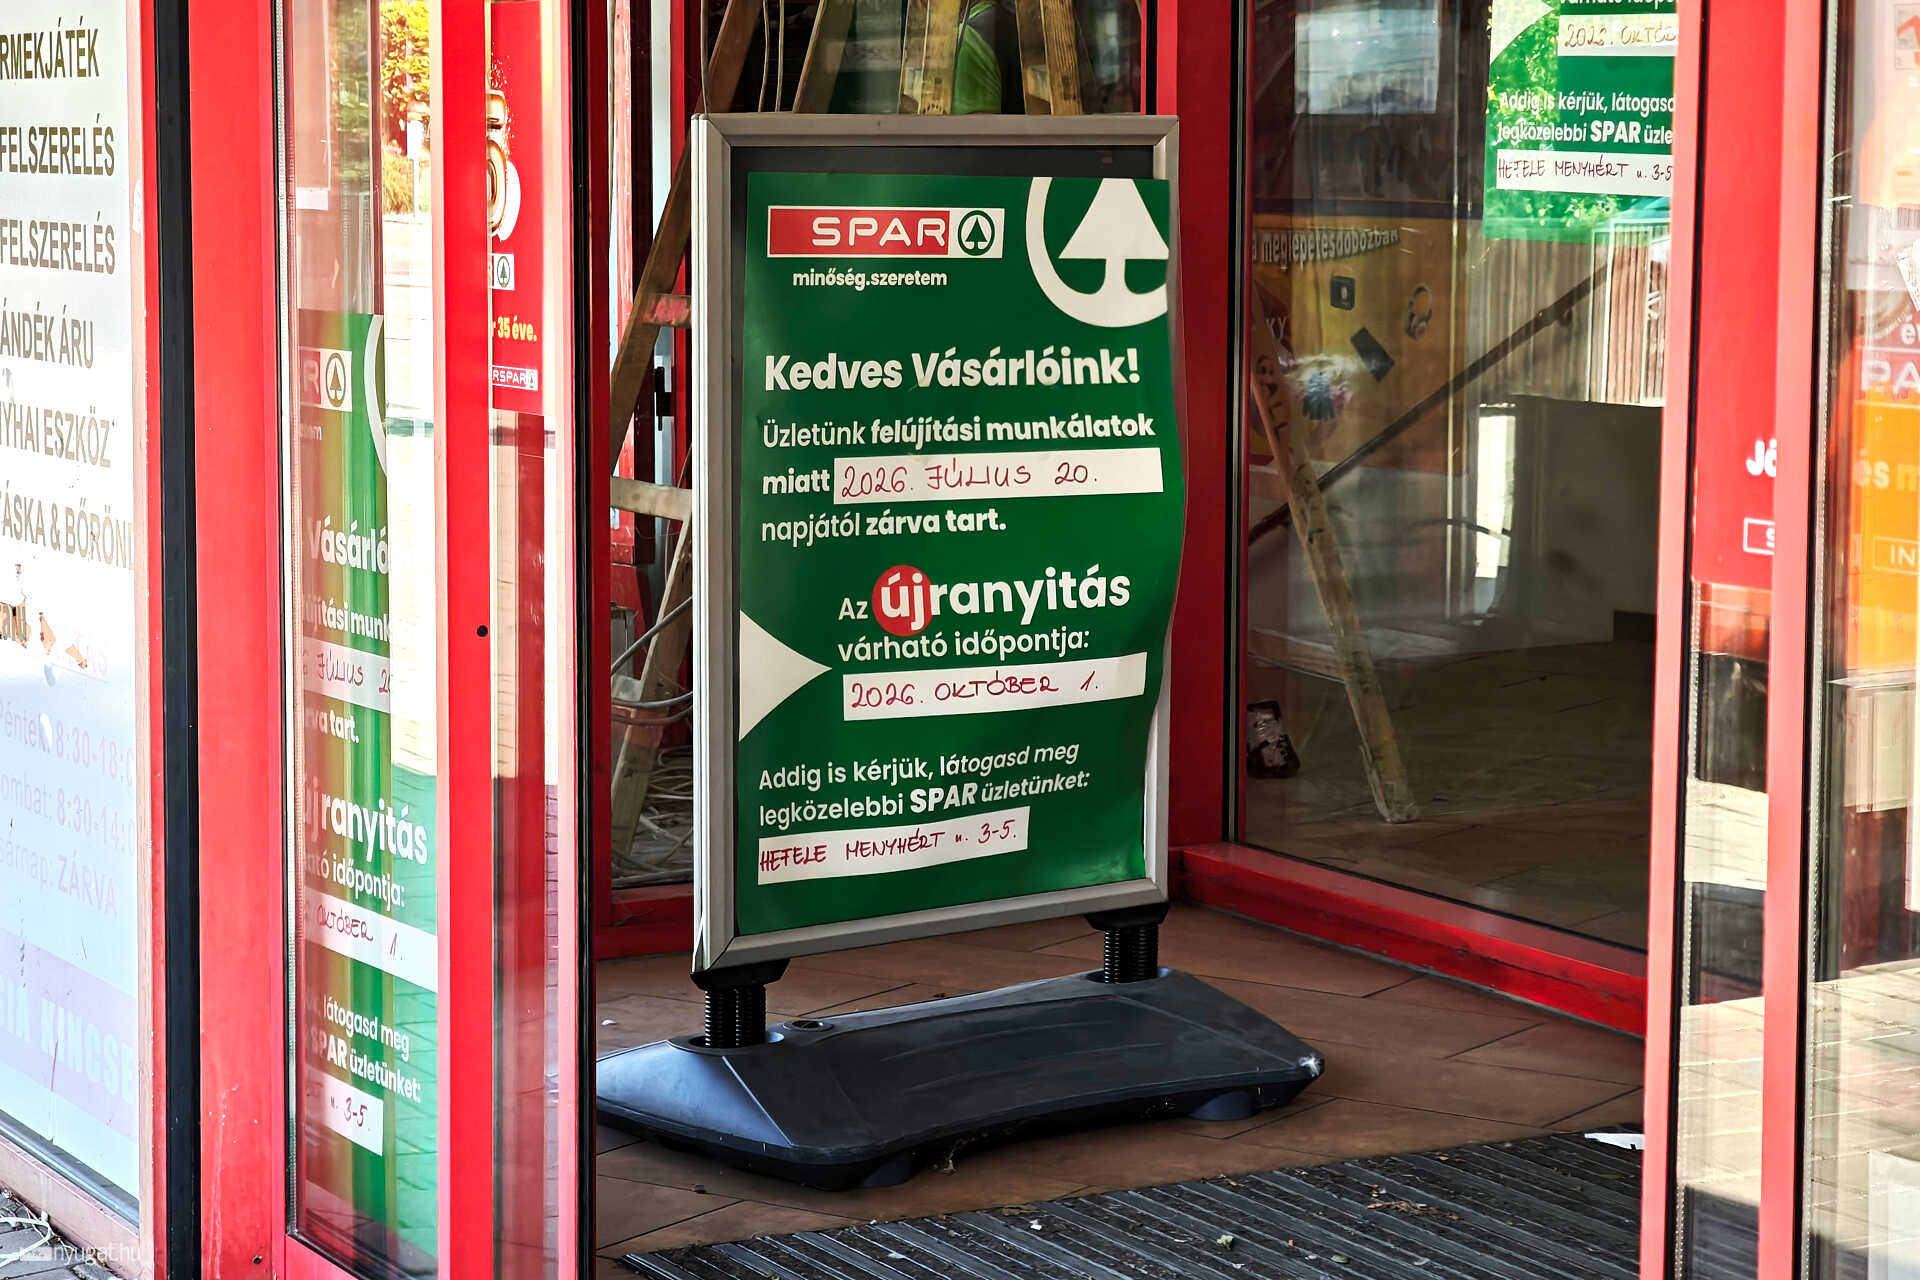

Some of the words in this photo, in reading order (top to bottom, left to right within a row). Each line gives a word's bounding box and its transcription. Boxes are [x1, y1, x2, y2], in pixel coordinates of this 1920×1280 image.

[1499, 92, 1540, 115] Addig
[1559, 91, 1608, 115] kérjük,
[1497, 120, 1587, 146] legközelebbi
[1590, 120, 1641, 143] SPAR
[1555, 155, 1629, 177] MENYHÉRT
[0, 211, 115, 275] FELSZERELÉS
[812, 217, 946, 246] SPAR
[792, 269, 947, 291] minőség.szeretem
[59, 304, 94, 369] ÁRU
[497, 316, 510, 339] 35
[512, 315, 537, 342] éve.
[764, 352, 903, 391] Kedves
[911, 346, 1141, 389] Vásárlóink!
[0, 400, 39, 453] YHAI
[44, 405, 111, 468] ESZKÖZ
[762, 420, 866, 448] Üzletünk
[870, 415, 982, 450] felújítási
[986, 413, 1156, 442] munkálatok
[762, 469, 830, 495] miatt
[841, 465, 915, 498] 2026.
[926, 457, 1032, 490] JÚLIUS
[1055, 461, 1099, 486] 20.
[0, 480, 46, 547] ÁSKA
[761, 511, 861, 547] napjától
[866, 507, 940, 536] zárva
[945, 507, 1007, 532] tart.
[838, 597, 869, 621] Az
[880, 563, 1131, 631] újranyitás
[838, 634, 948, 662] várható
[954, 627, 1090, 660] időpontja:
[317, 650, 364, 686] JÚLIUS
[850, 682, 924, 709] 2026.
[934, 669, 1060, 702] OKTÓBER
[1080, 670, 1100, 692] 1.
[330, 708, 360, 743] tart.
[758, 766, 822, 794] Addig
[828, 762, 847, 785] is
[852, 757, 934, 786] kérjük,
[939, 745, 1030, 780] látogasd
[1033, 741, 1080, 767] meg
[759, 793, 905, 831] legközelebbi
[910, 784, 978, 814] SPAR
[981, 770, 1090, 805] üzletünket:
[845, 829, 946, 860] MENYHÉRT
[978, 819, 1017, 845] 3-5.
[332, 853, 405, 913] időpontja:
[324, 994, 378, 1041] látogasd
[381, 1025, 409, 1062] meg
[350, 1048, 422, 1103] üzletünket:
